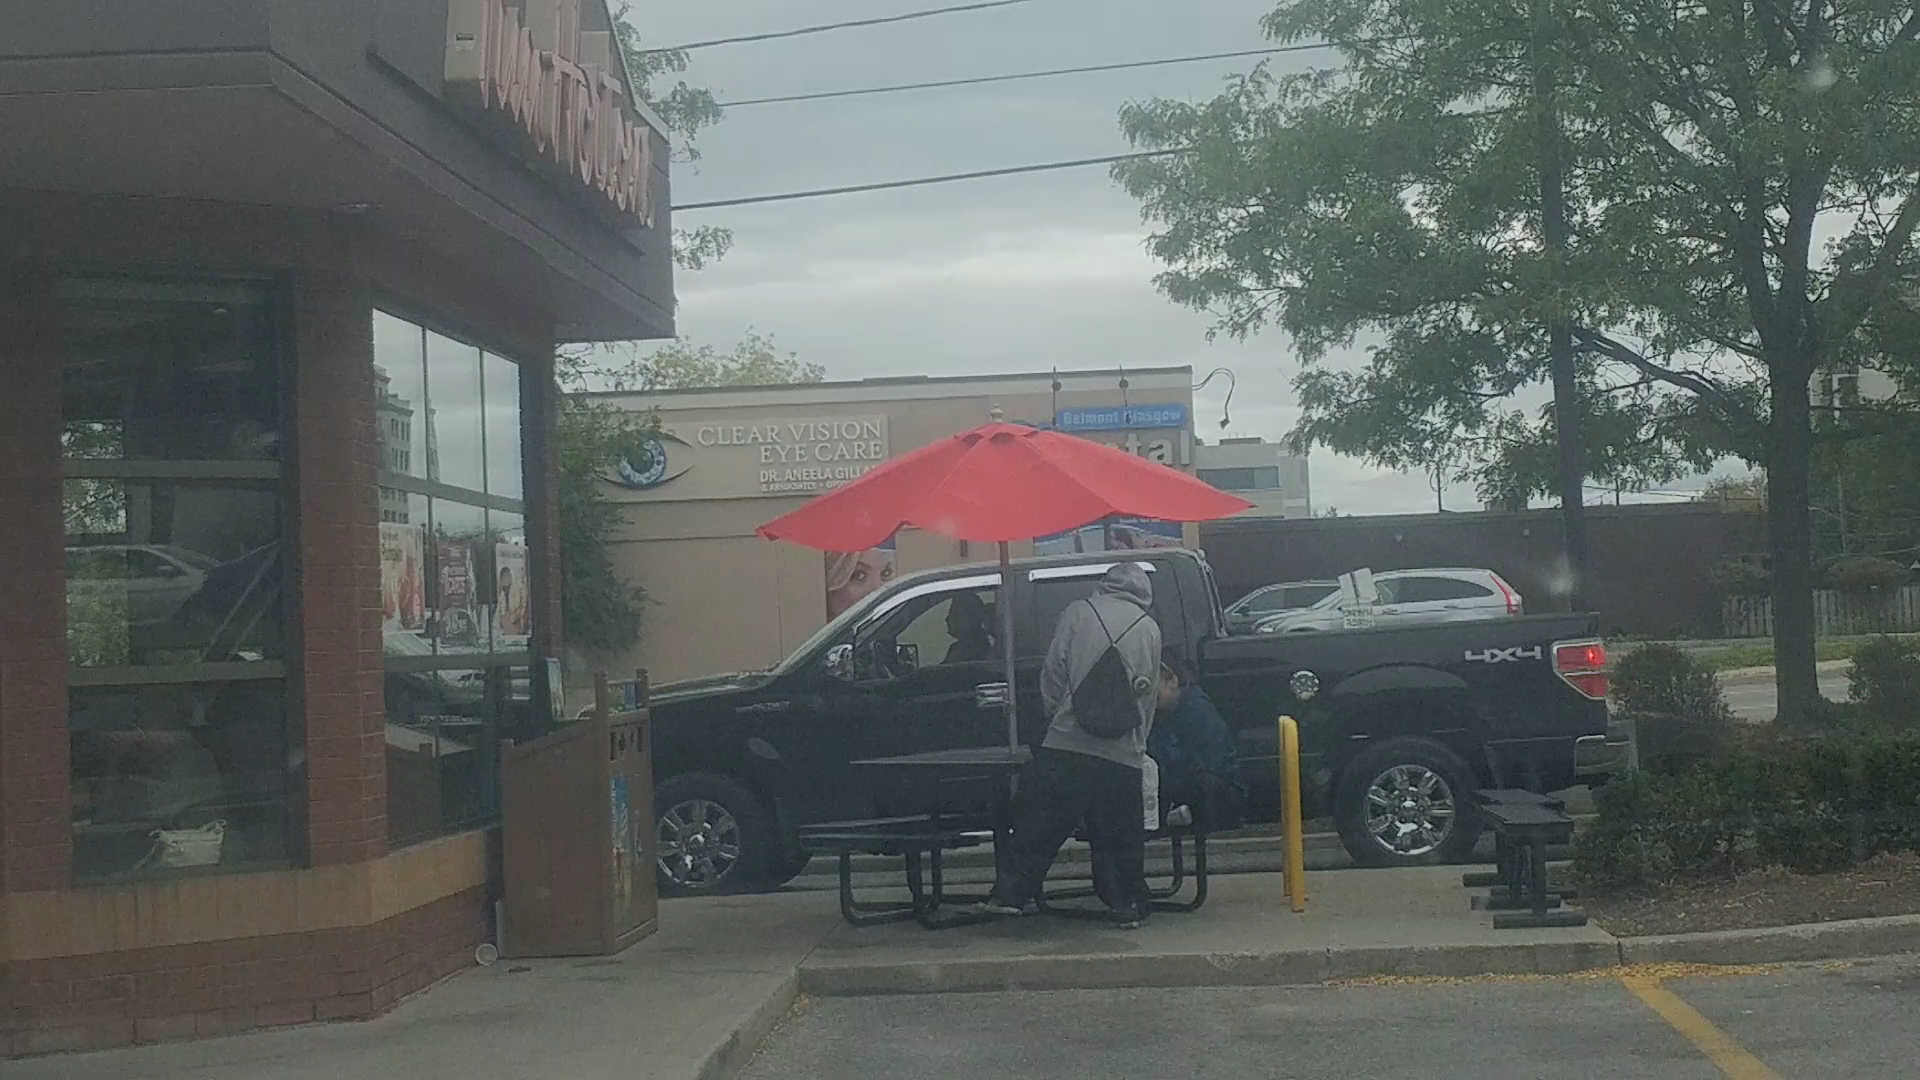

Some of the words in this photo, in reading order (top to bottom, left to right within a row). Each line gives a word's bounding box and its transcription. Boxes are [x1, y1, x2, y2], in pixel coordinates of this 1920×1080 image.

[1063, 411, 1119, 425] Belmont
[697, 423, 781, 446] CLEAR
[788, 419, 882, 441] VISION
[760, 444, 808, 464] EYE
[815, 441, 883, 461] CARE
[1105, 430, 1190, 465] tal
[760, 469, 781, 482] DR.
[785, 467, 833, 480] ANEELA
